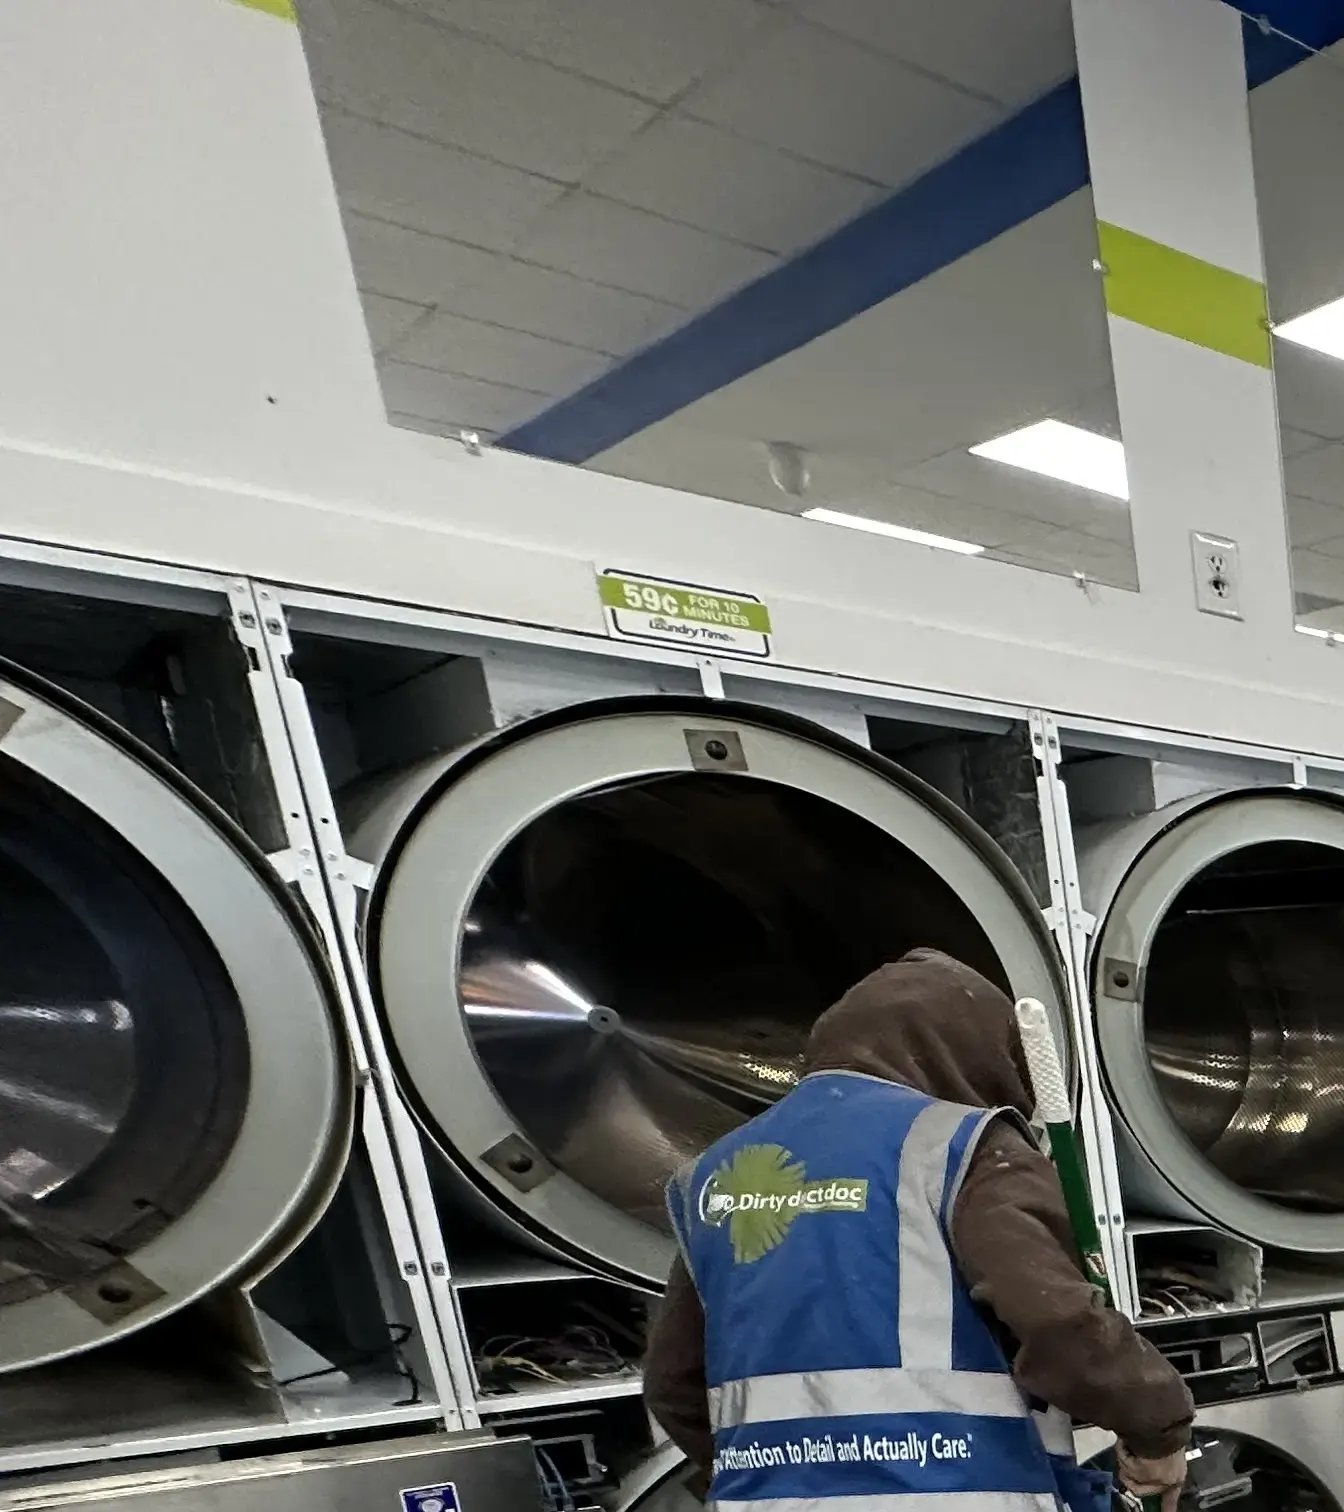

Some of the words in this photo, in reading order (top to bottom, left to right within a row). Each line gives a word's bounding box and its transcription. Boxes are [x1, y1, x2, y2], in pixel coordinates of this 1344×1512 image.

[622, 583, 679, 616] 59¢
[688, 595, 720, 610] FOR
[724, 602, 740, 614] 10
[682, 605, 749, 626] MINUTES
[649, 619, 699, 638] Laundry
[701, 628, 729, 641] Time
[786, 1439, 802, 1470] to
[803, 1435, 836, 1463] Detail
[837, 1434, 861, 1462] and
[863, 1432, 928, 1467] Actually
